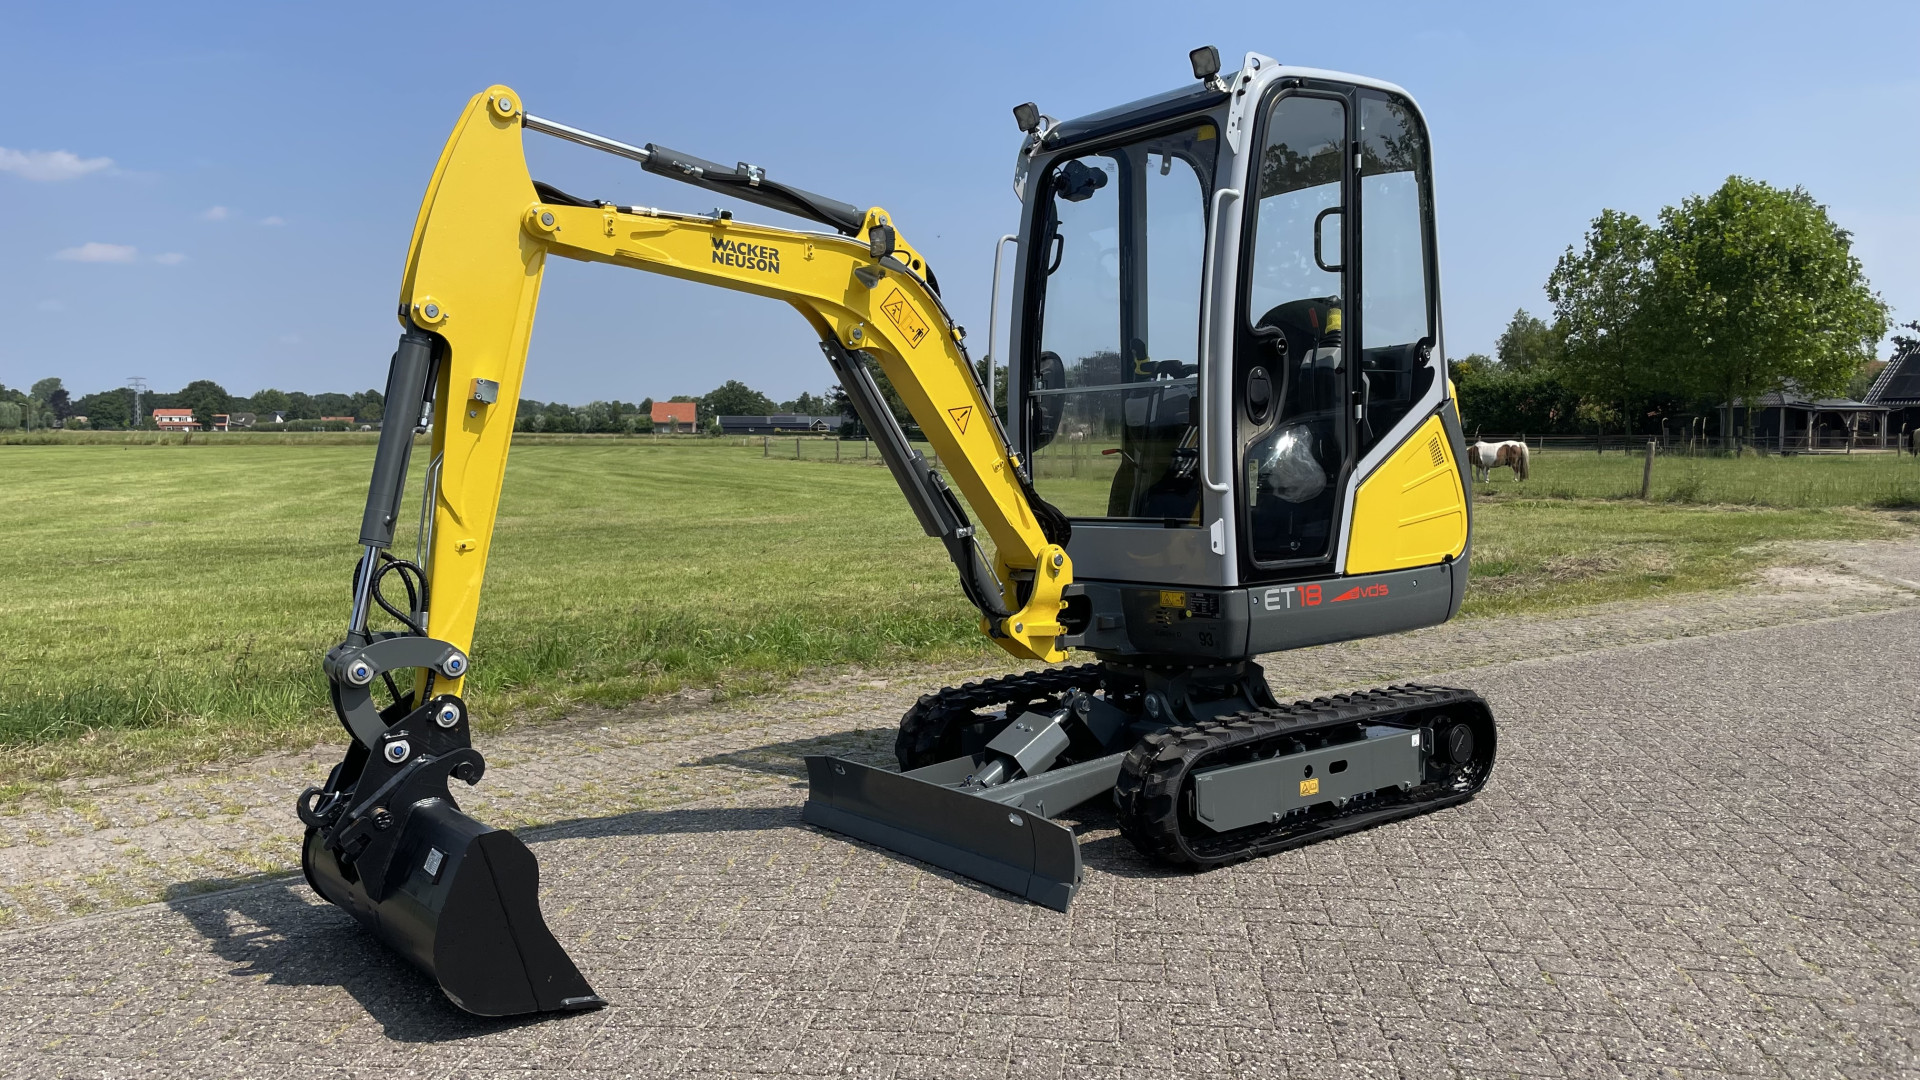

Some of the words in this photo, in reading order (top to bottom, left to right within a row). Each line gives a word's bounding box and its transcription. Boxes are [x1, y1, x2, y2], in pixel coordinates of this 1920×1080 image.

[711, 237, 780, 261] WACKER
[711, 251, 780, 274] NEUSON
[1198, 631, 1214, 647] 93
